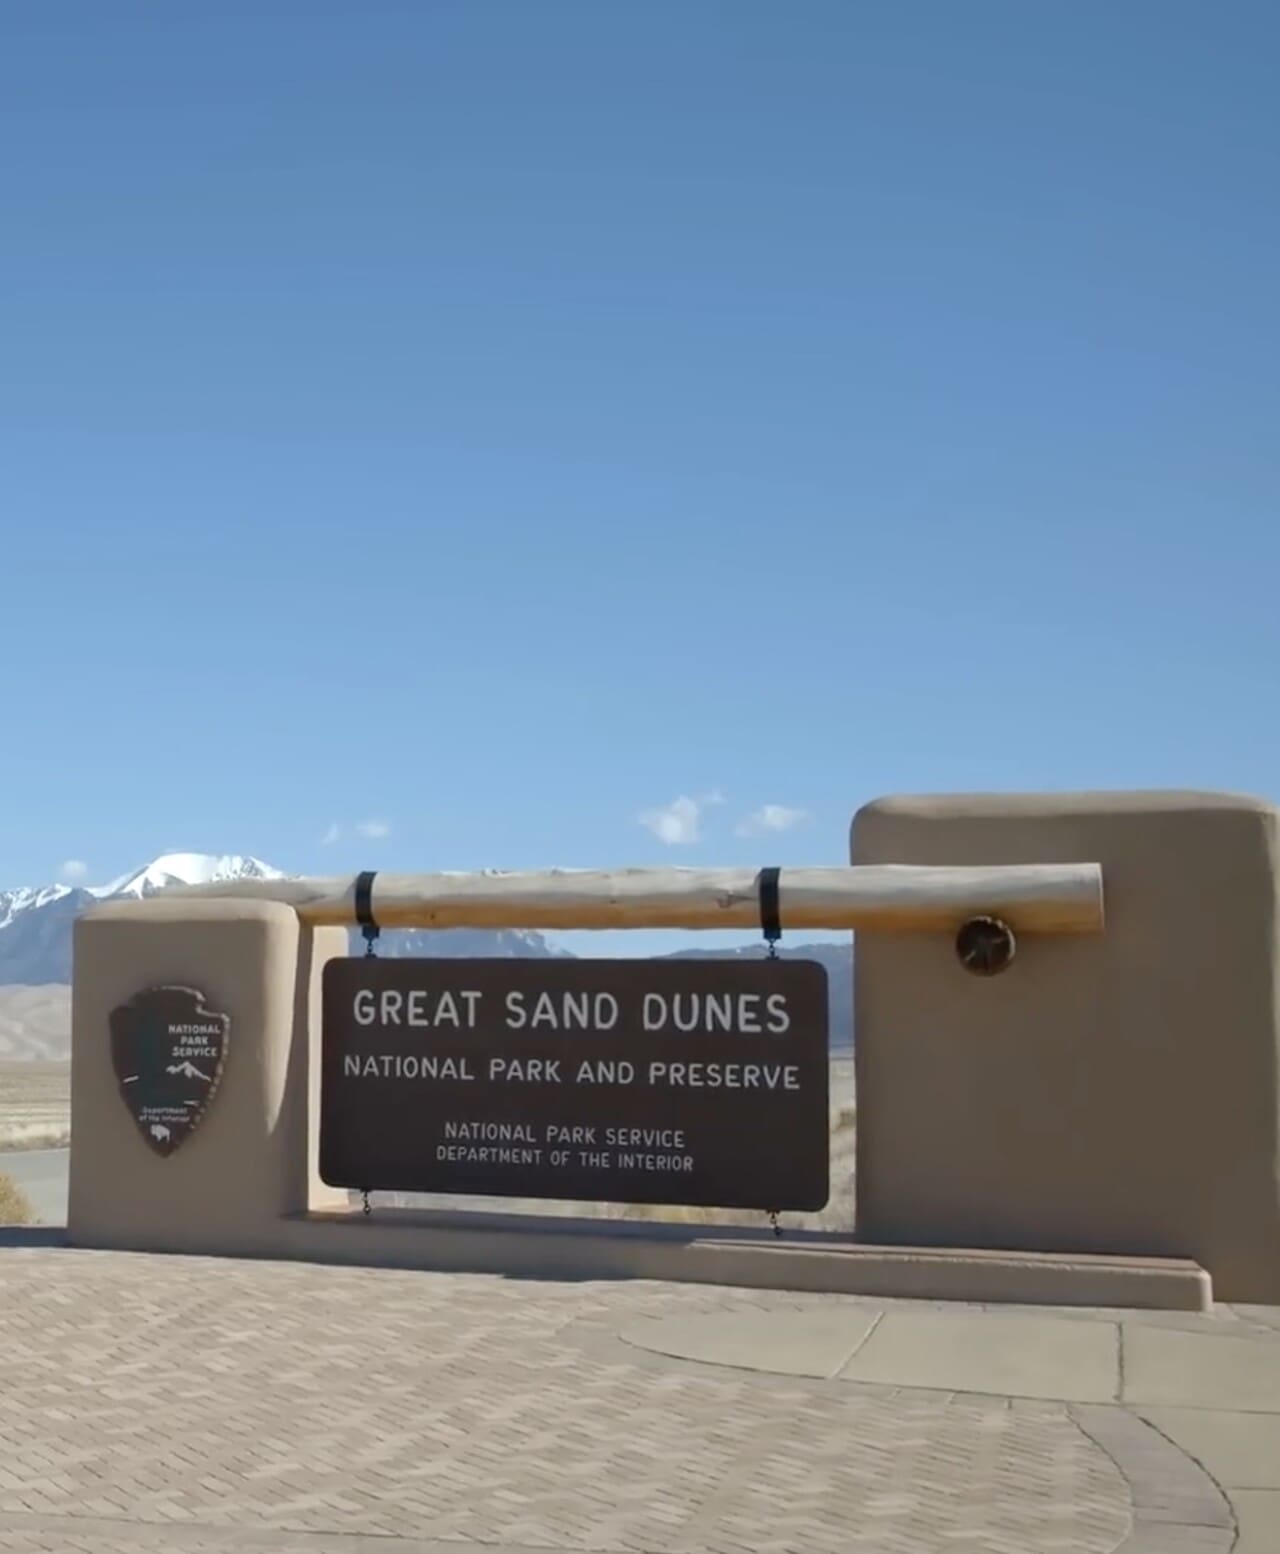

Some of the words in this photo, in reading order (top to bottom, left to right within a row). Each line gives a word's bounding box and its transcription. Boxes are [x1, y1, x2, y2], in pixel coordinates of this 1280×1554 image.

[353, 989, 483, 1028] GREAT
[505, 991, 619, 1030] SAND
[642, 992, 791, 1034] DUNES
[168, 1024, 221, 1034] NATIONAL
[180, 1035, 209, 1045] PARK
[172, 1046, 218, 1057] SERVICE
[344, 1054, 475, 1081] NATIONAL
[489, 1058, 561, 1084] PARK
[576, 1060, 635, 1085] AND
[649, 1062, 801, 1090] PRESERVE
[444, 1121, 537, 1143] NATIONAL
[546, 1125, 596, 1145] PARK
[605, 1127, 685, 1148] SERVICE
[436, 1145, 543, 1165] DEPARTMENT
[550, 1150, 571, 1166] OF
[579, 1152, 611, 1168] THE
[618, 1153, 694, 1172] INTERIOR
